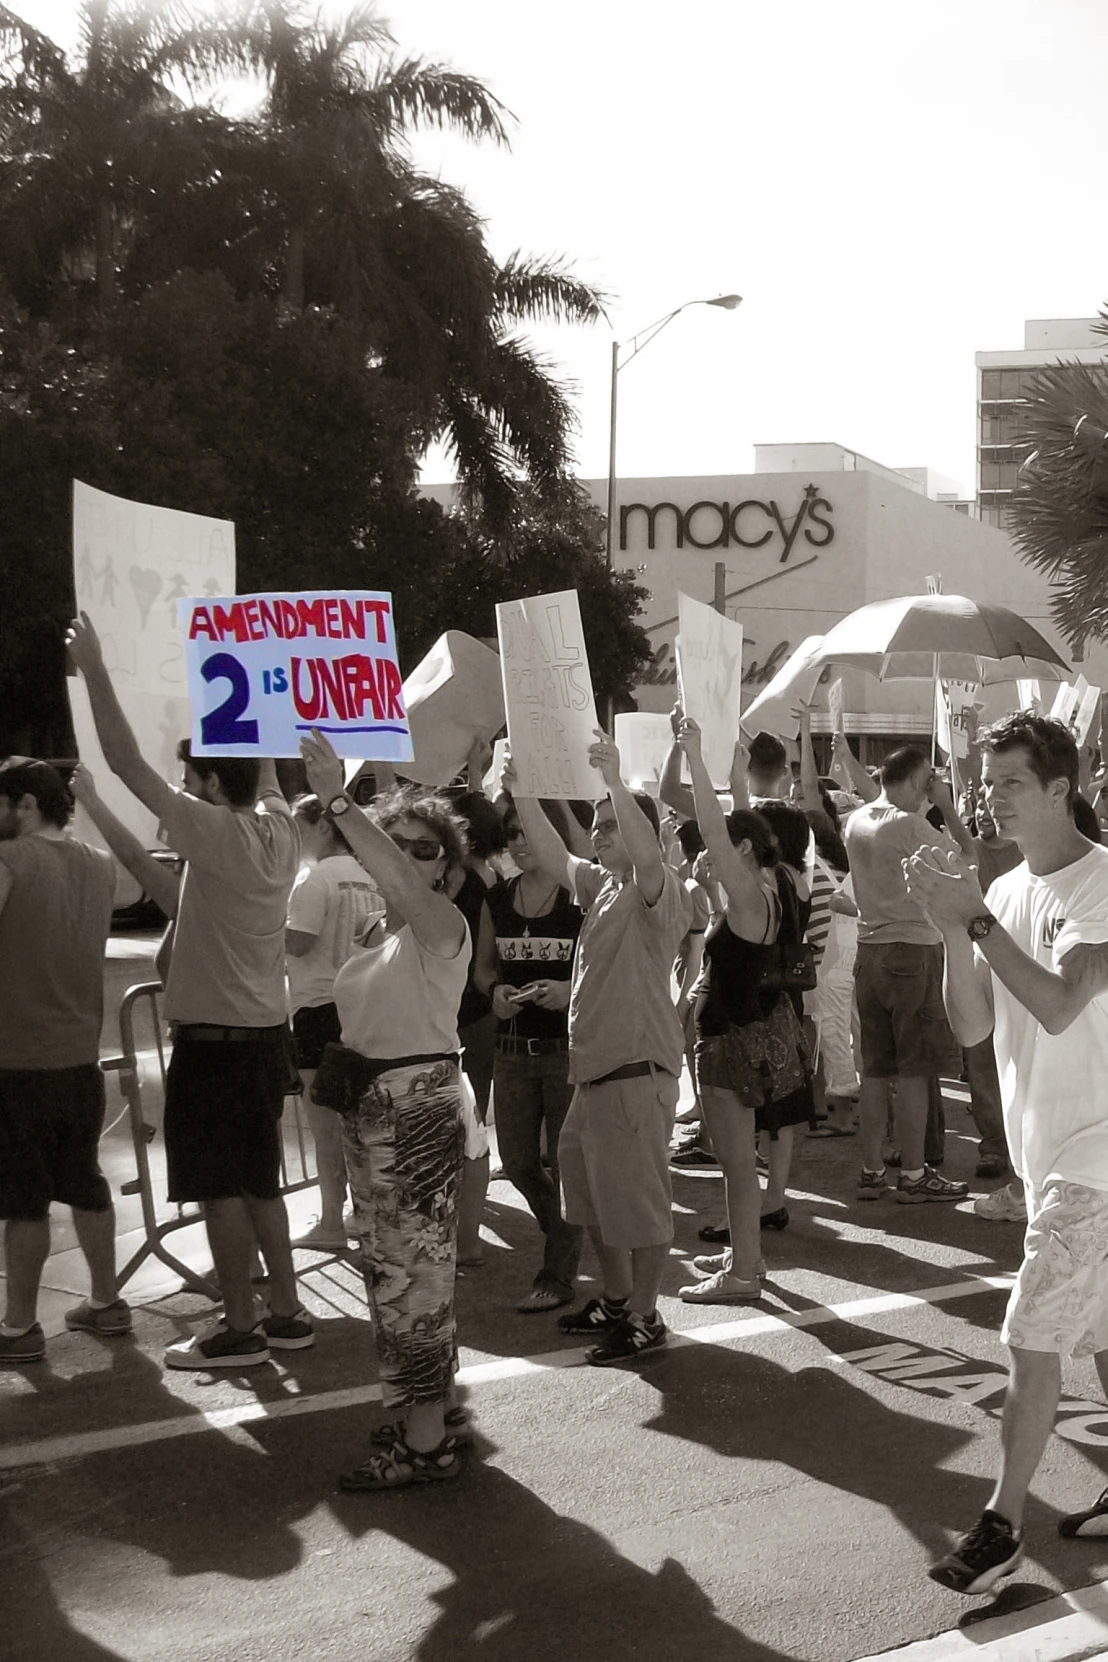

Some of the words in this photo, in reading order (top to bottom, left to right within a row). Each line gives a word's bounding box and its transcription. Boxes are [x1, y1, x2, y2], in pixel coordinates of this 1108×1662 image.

[620, 483, 835, 563] macy's
[188, 598, 391, 644] AMENDMENT
[200, 652, 260, 745] 2
[263, 667, 289, 695] IS
[290, 653, 406, 721] UNFAIR
